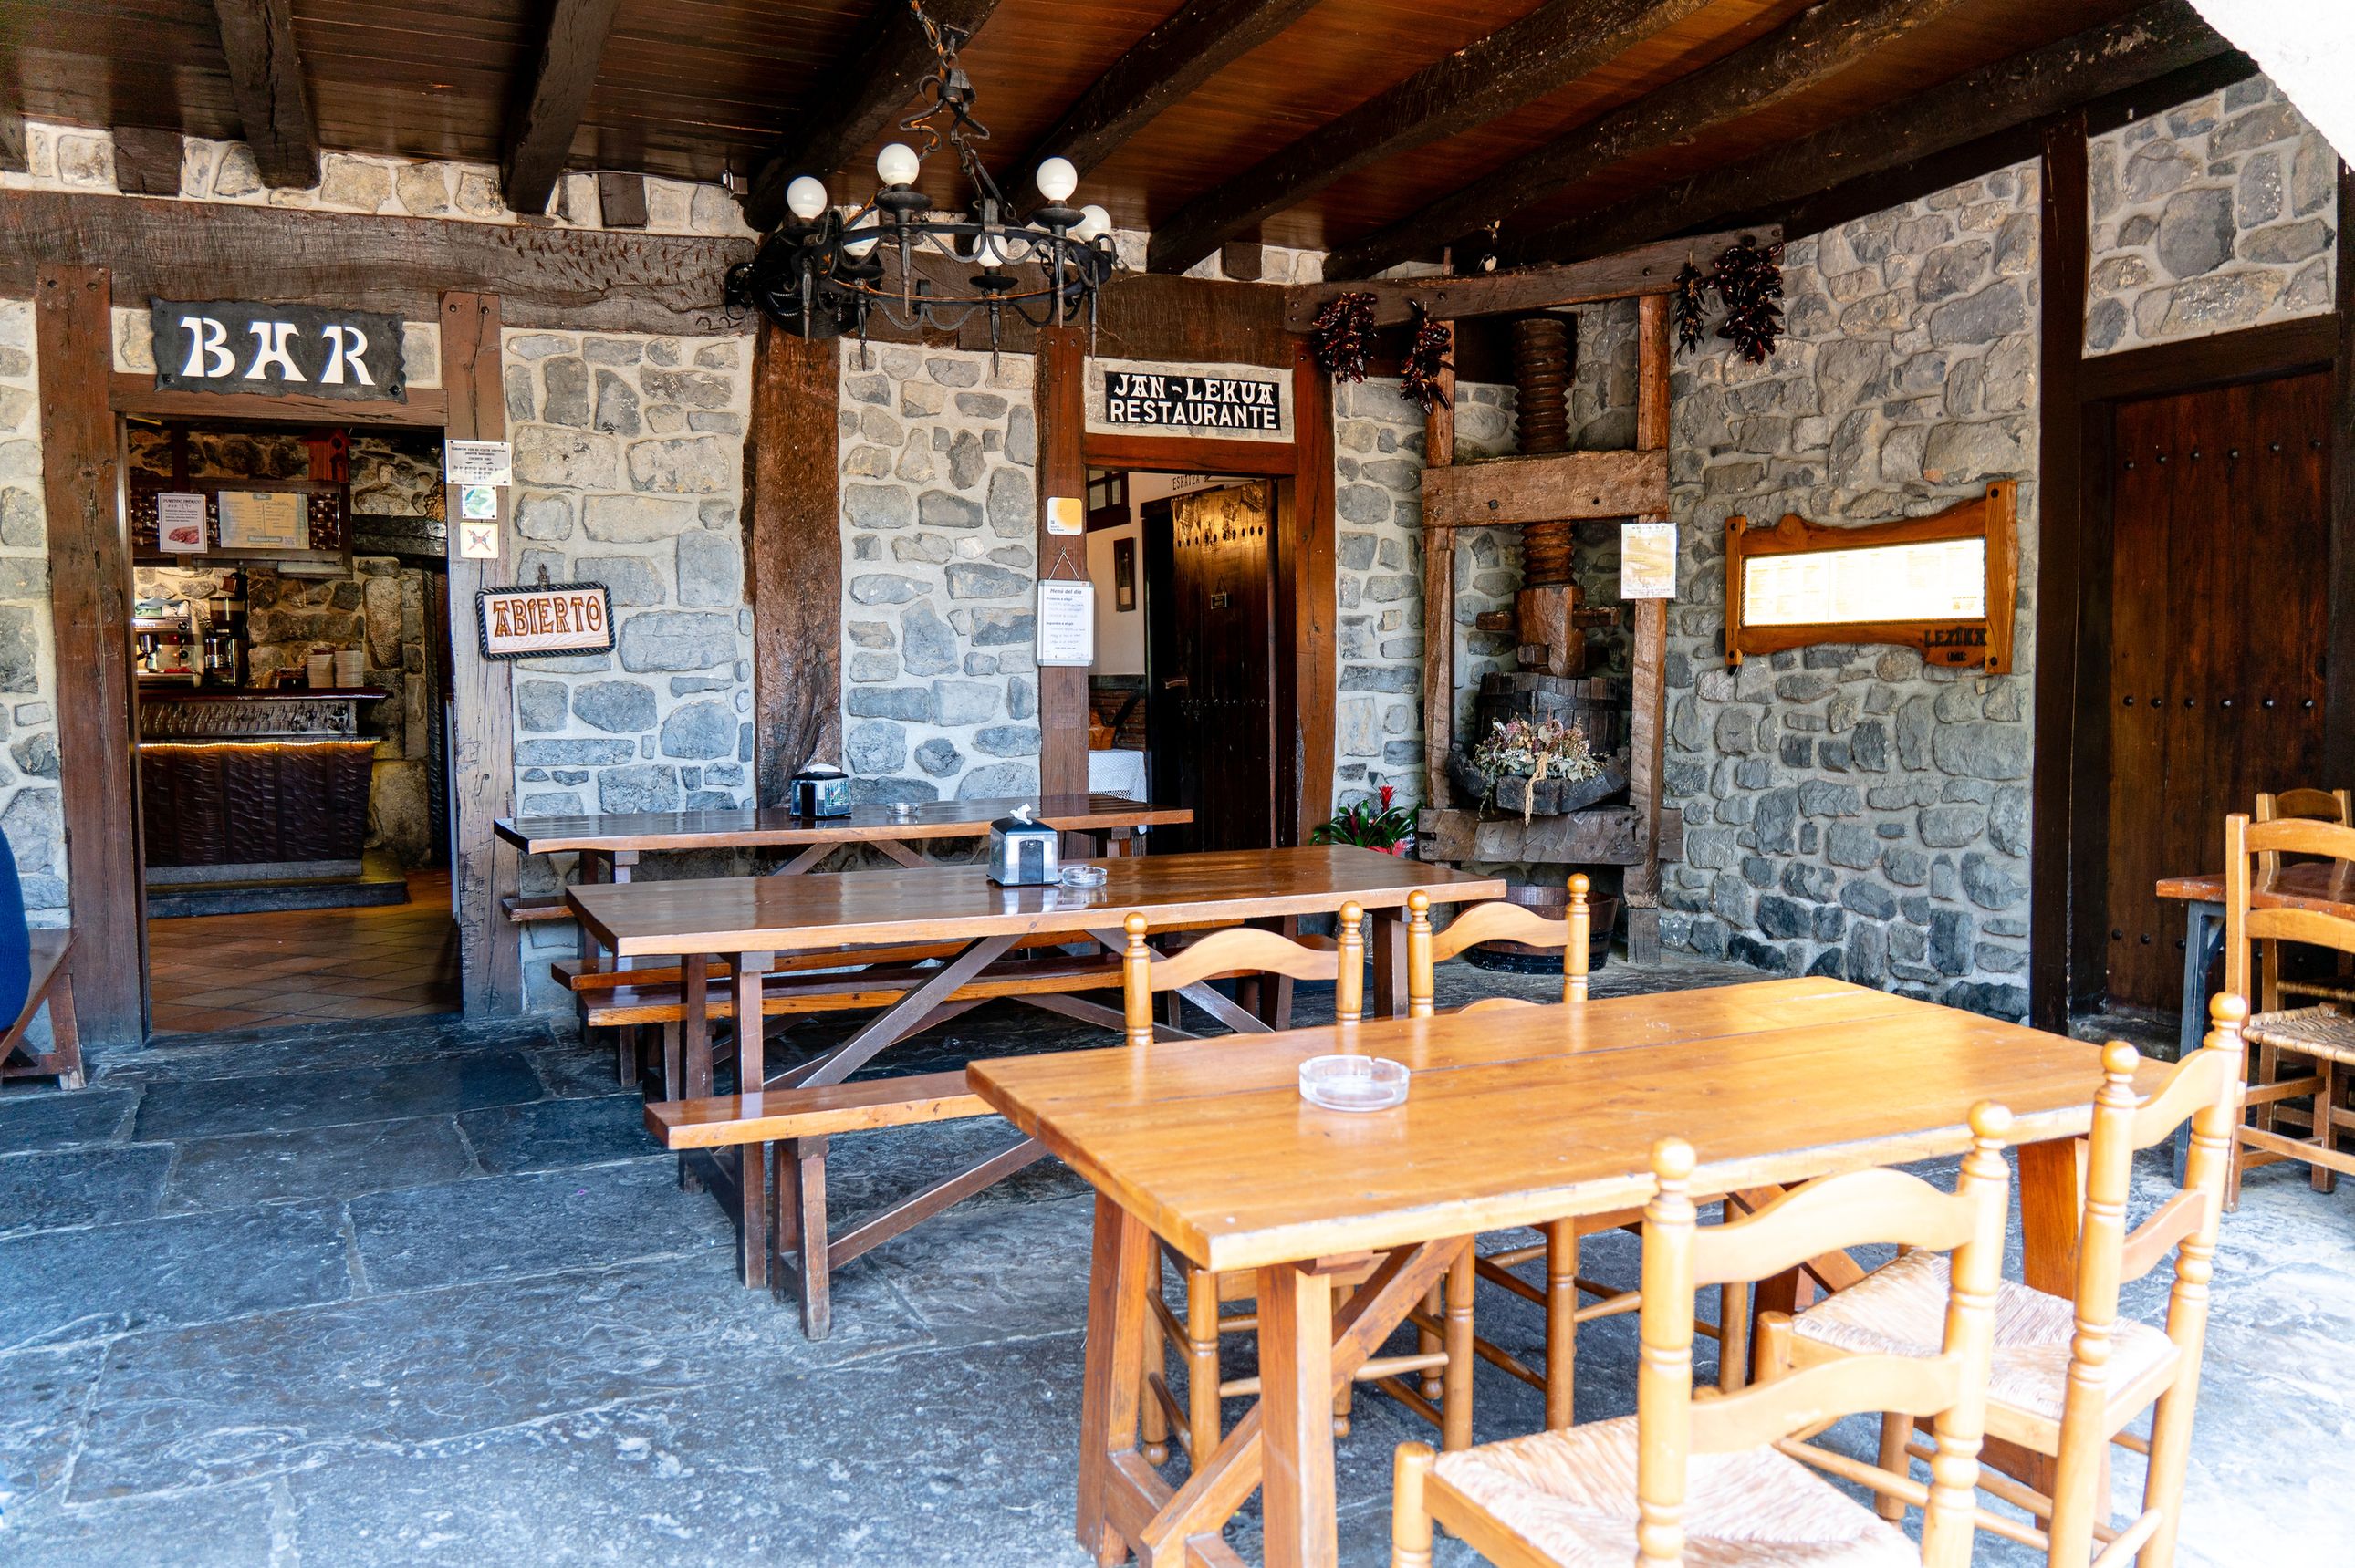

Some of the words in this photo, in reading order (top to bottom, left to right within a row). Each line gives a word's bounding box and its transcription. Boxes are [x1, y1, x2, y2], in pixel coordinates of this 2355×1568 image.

[180, 316, 376, 386] BAR
[1110, 399, 1277, 430] RESTAURANTE
[492, 595, 602, 639] ABIERTO
